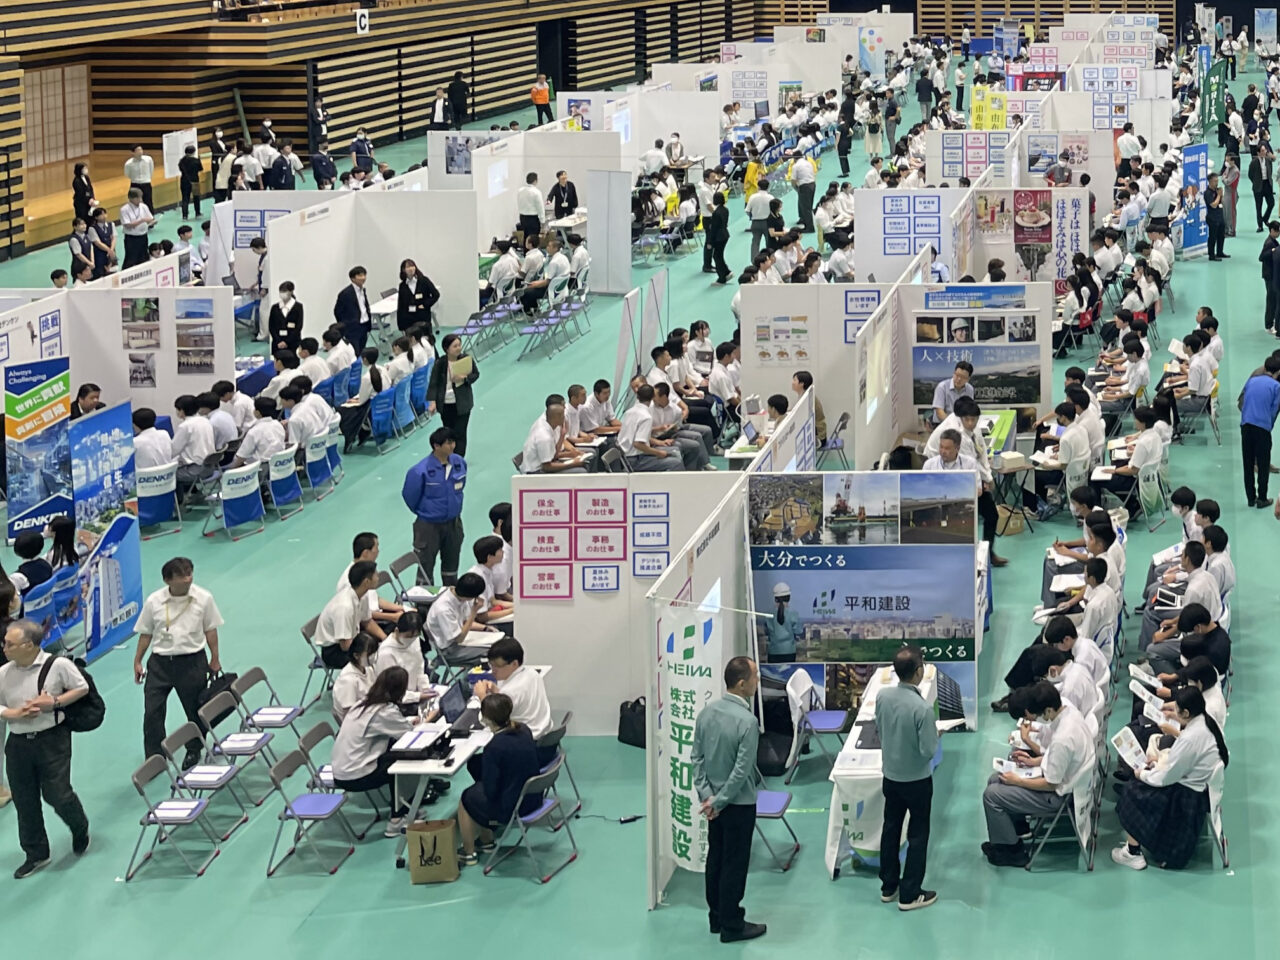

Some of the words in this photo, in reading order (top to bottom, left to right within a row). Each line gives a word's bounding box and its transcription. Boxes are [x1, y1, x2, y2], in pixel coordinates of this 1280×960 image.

[358, 12, 367, 31] C
[41, 312, 60, 333] 挑戦
[8, 369, 32, 378] Always
[8, 373, 47, 385] Challenging
[537, 498, 555, 508] 保全
[591, 498, 610, 507] 製造
[531, 509, 561, 517] のお仕事
[586, 508, 615, 517] のお仕事
[537, 535, 555, 544] 検査
[591, 535, 610, 544] 事務
[531, 545, 561, 554] のお仕事
[586, 545, 615, 554] のお仕事
[757, 550, 847, 568] 大分でつくる
[537, 572, 556, 581] 営業
[531, 582, 561, 591] のお仕事
[844, 594, 912, 613] 平和建設
[670, 687, 697, 705] 株式
[670, 702, 696, 721] 会社
[669, 720, 695, 863] 平和建設
[419, 854, 442, 868] Lee
